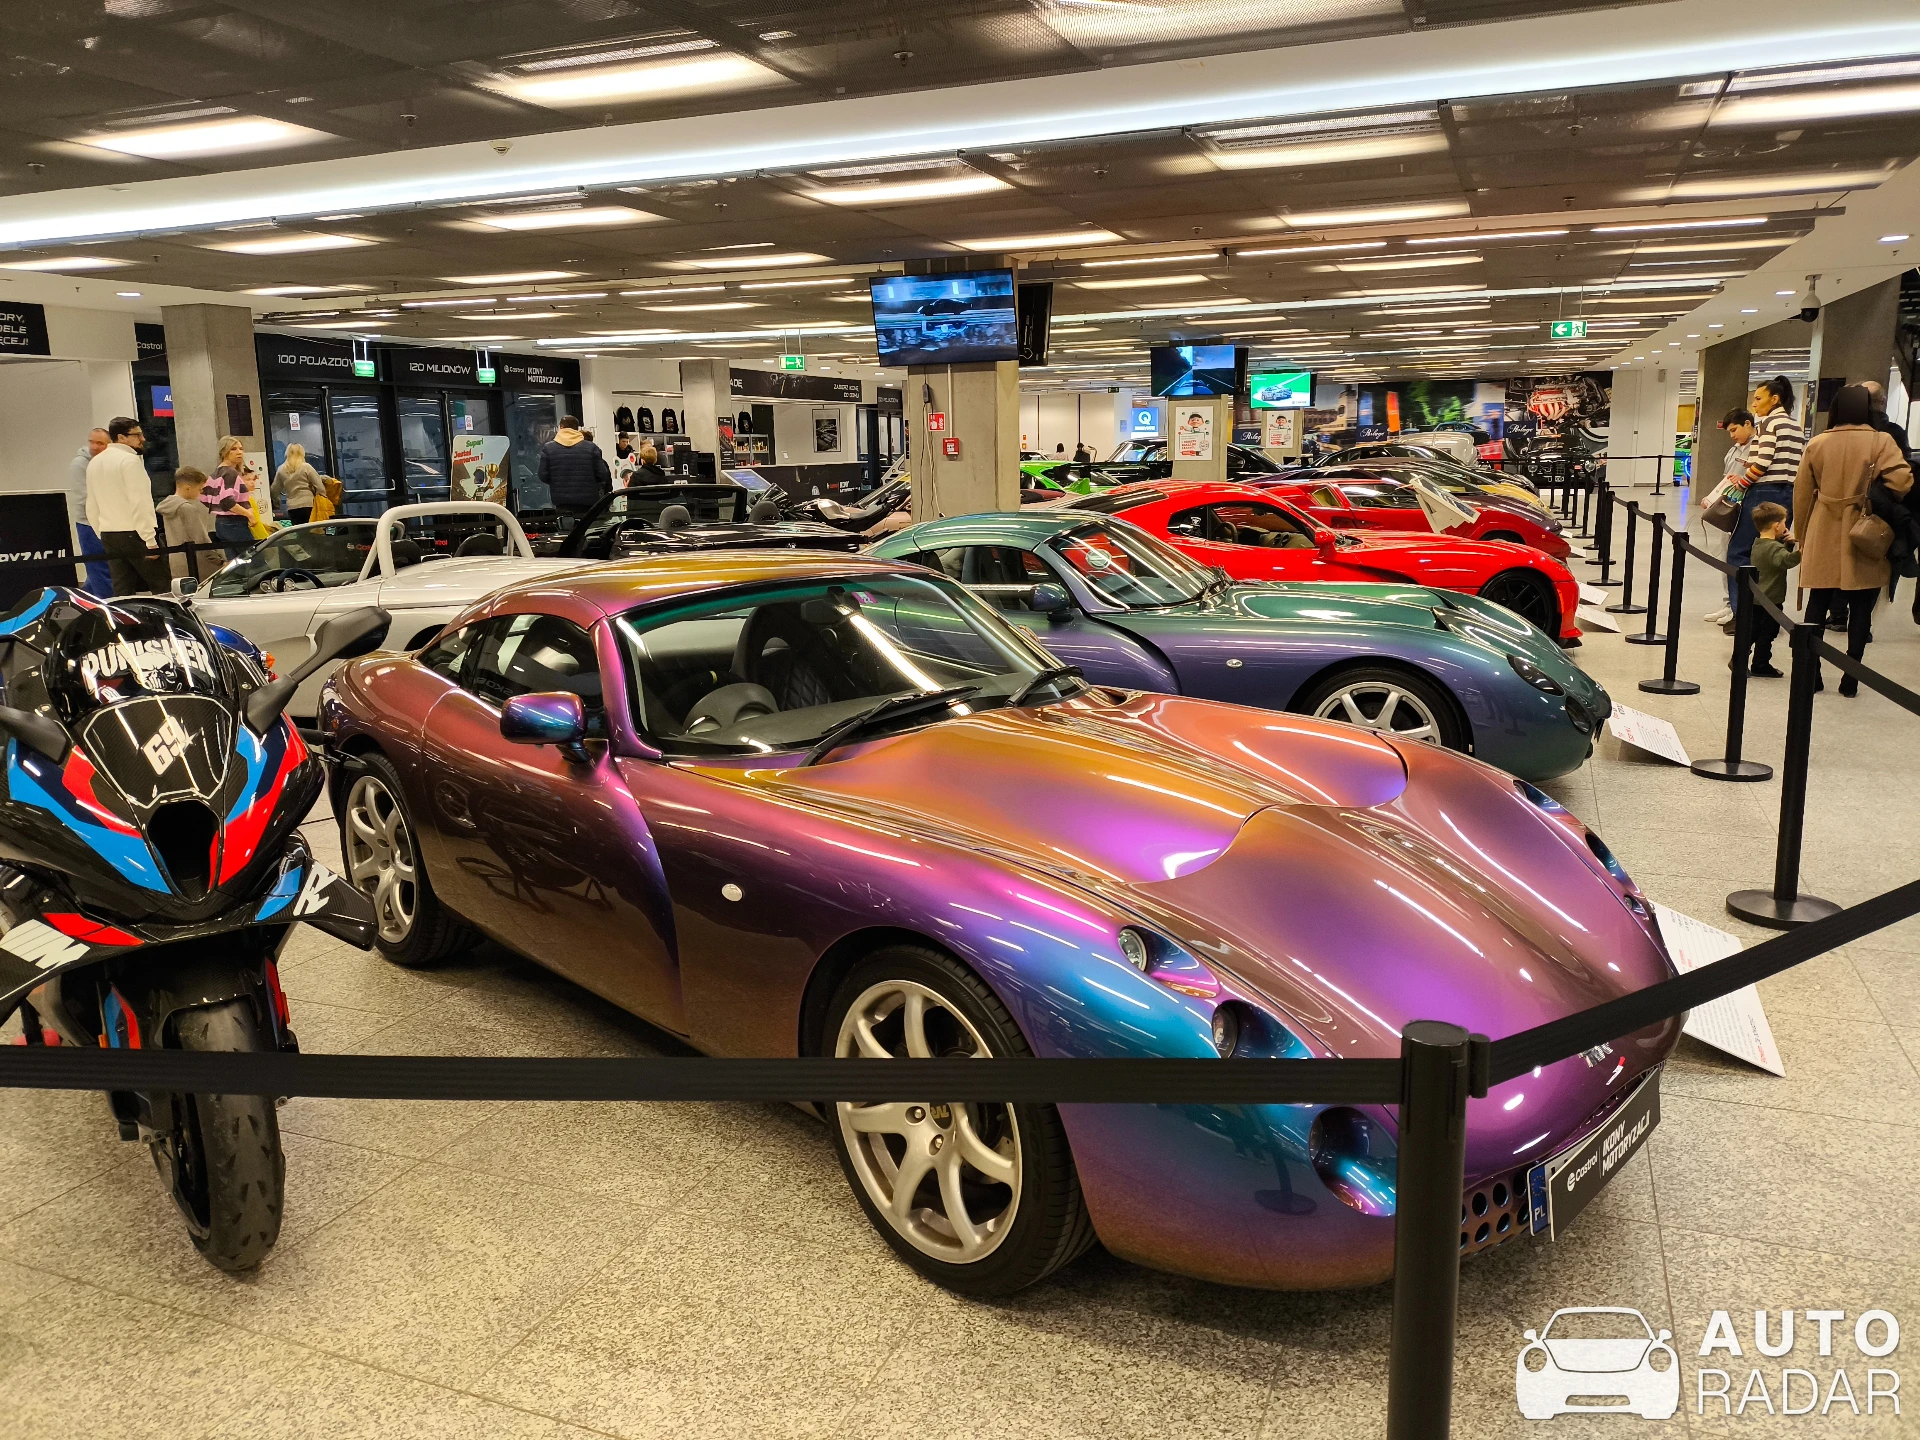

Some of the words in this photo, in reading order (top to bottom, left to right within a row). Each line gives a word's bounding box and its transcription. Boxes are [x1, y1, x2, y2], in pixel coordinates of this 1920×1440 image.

[137, 341, 163, 350] Castrol
[278, 355, 296, 365] 100
[409, 362, 425, 372] 120
[427, 364, 471, 374] MILIONÓW
[528, 367, 544, 375] IKONY
[528, 375, 563, 384] MOTORYZACJI
[81, 638, 217, 695] PUNISHER
[140, 714, 192, 776] 69
[1602, 1119, 1626, 1157] IKONY
[1602, 1109, 1651, 1177] MOTORYZACJI
[1575, 1150, 1598, 1182] Castrol
[1534, 1204, 1546, 1222] PL
